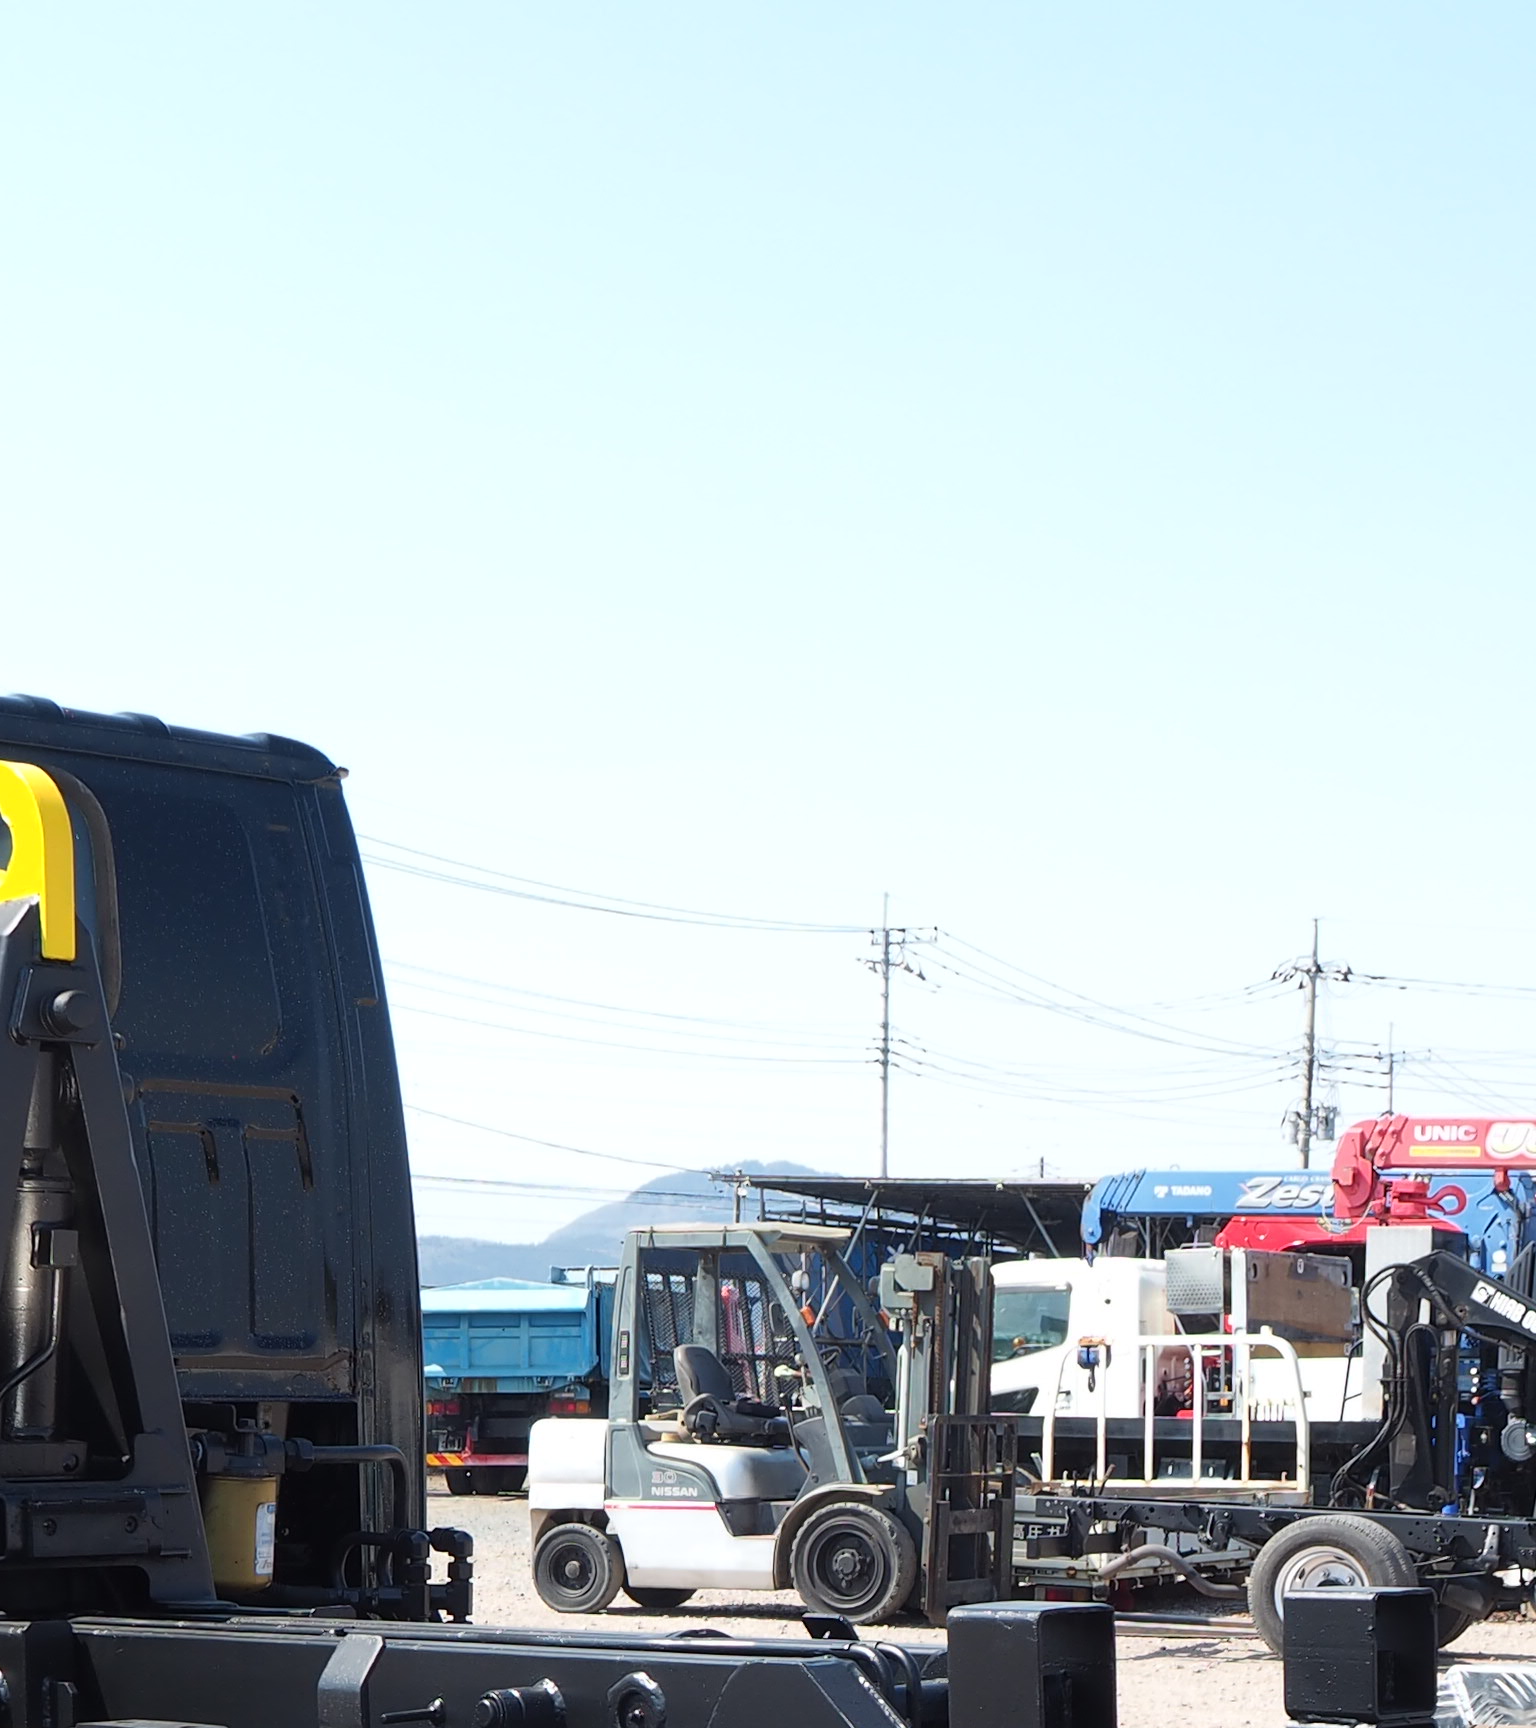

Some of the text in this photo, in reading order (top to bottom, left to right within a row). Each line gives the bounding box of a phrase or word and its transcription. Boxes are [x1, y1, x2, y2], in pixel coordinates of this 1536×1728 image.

[1414, 1125, 1478, 1143] UNIC
[1171, 1185, 1212, 1197] TADANO
[1489, 1290, 1526, 1324] HIAB
[651, 1486, 698, 1498] NISSAN
